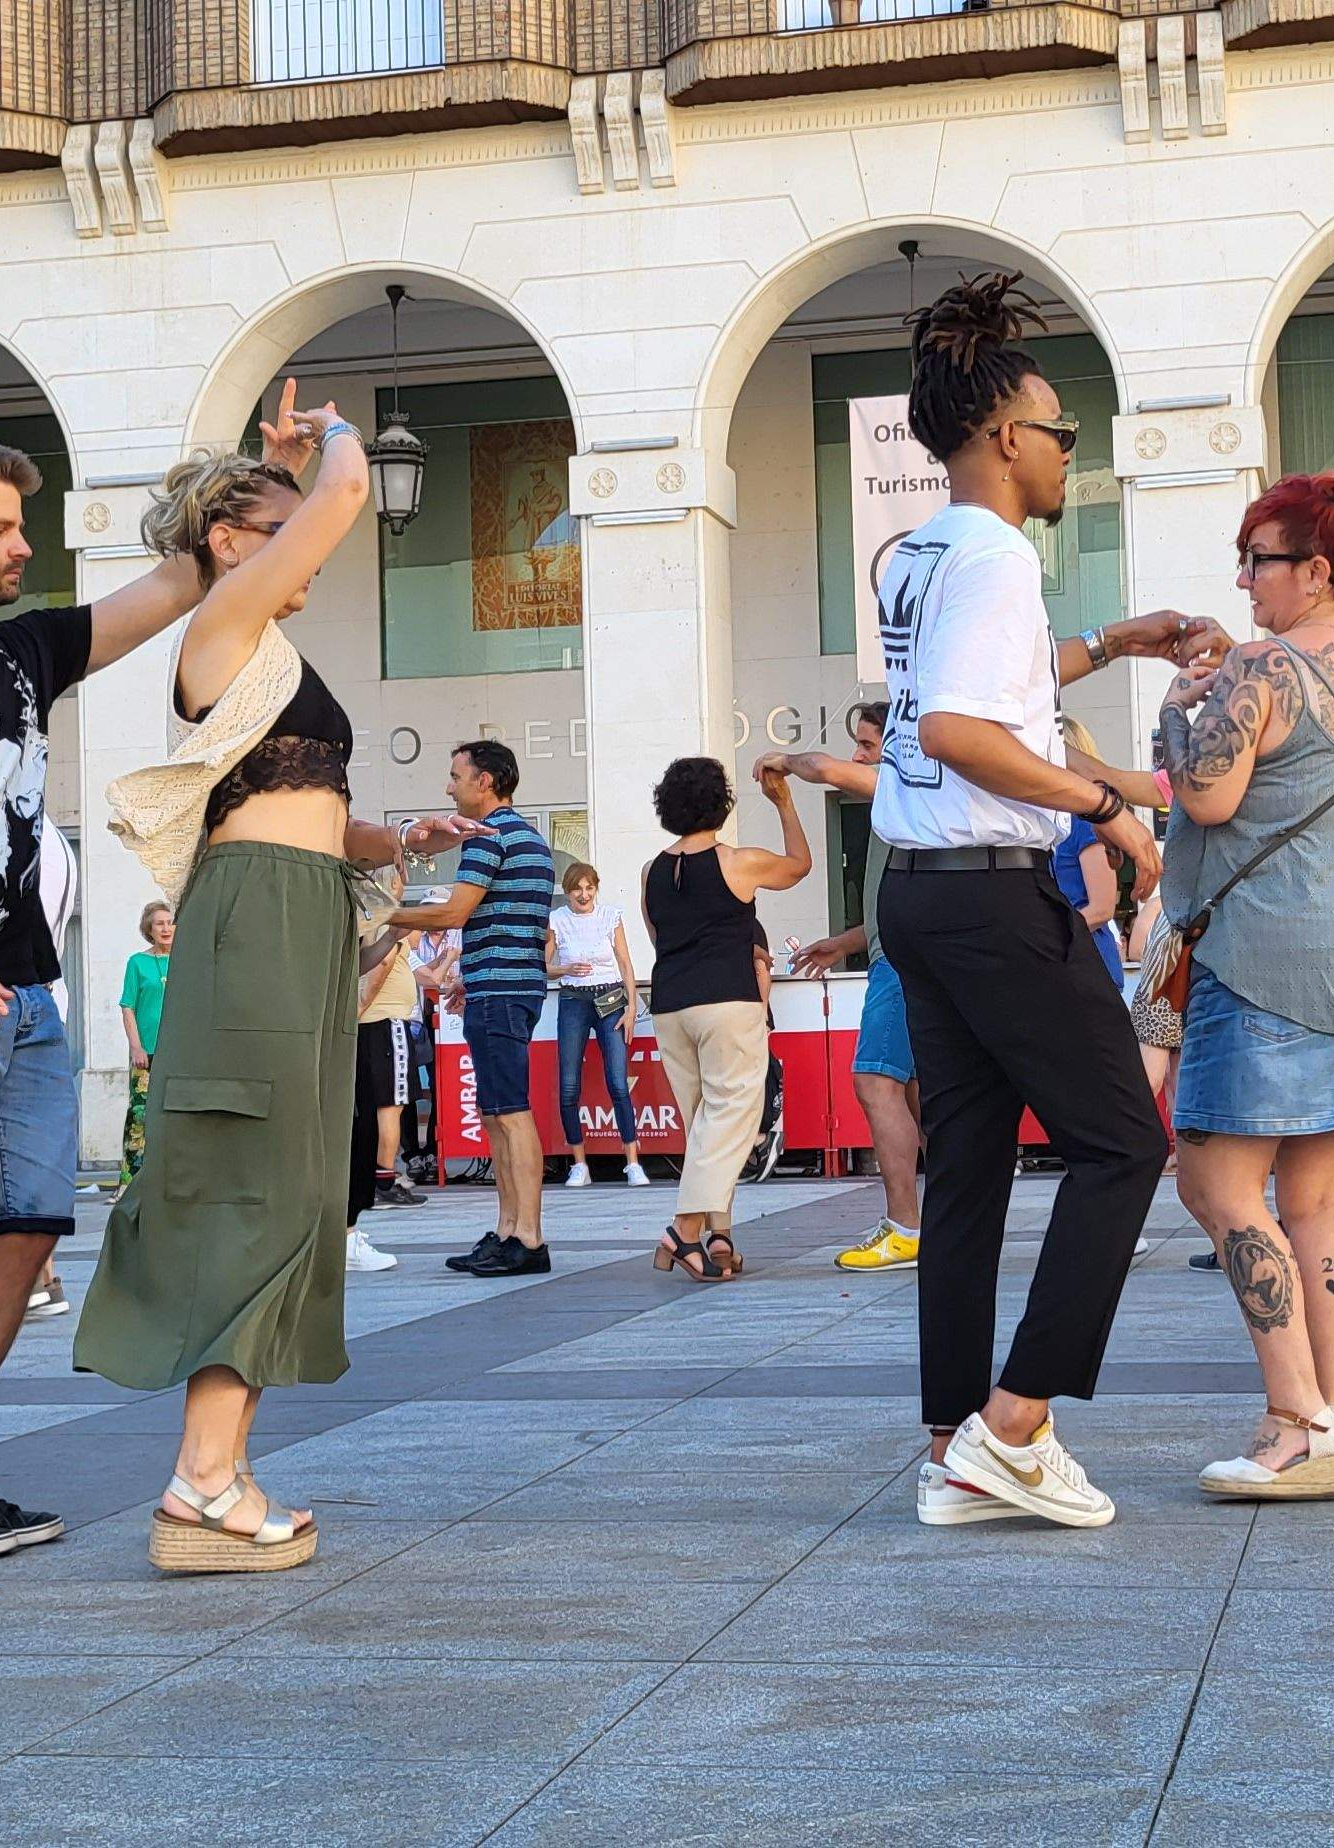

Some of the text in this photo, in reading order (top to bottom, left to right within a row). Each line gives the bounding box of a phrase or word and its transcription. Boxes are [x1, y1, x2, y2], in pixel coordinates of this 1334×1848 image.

[515, 583, 562, 592] EDITORIAL
[509, 590, 568, 604] LUIS VIVES
[578, 1106, 680, 1130] AMAR
